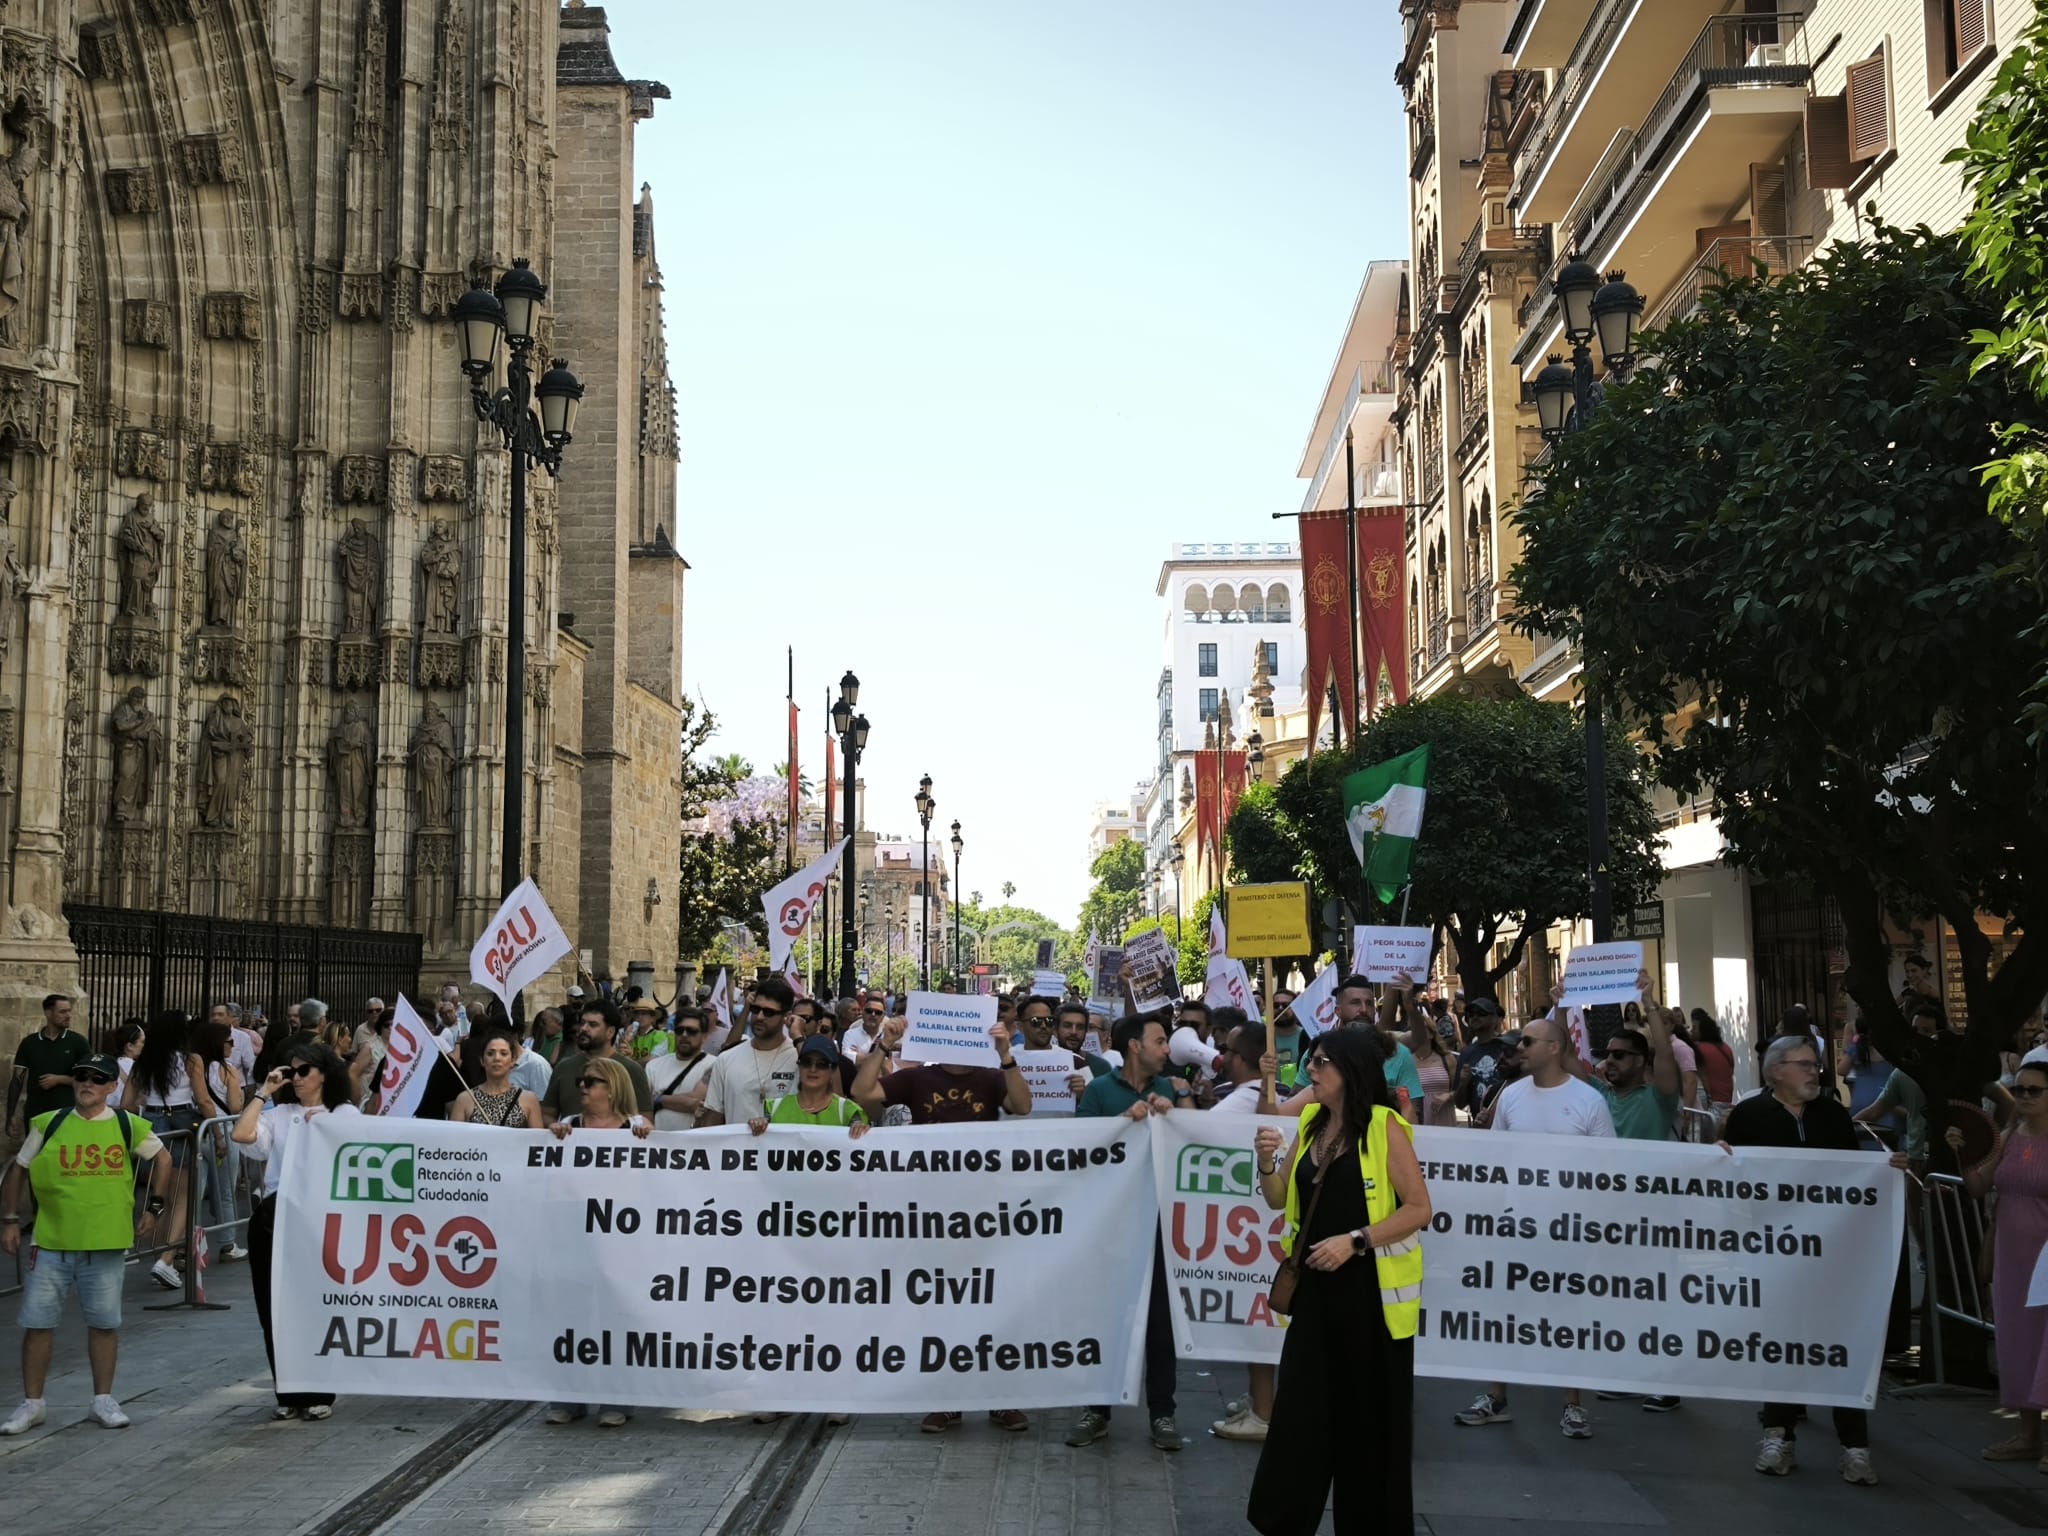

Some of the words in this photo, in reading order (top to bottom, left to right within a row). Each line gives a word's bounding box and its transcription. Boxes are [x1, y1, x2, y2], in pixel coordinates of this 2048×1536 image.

[1396, 940, 1426, 948] SUELDO
[1587, 954, 1614, 962] SALARIO
[1589, 969, 1616, 977] SALARIO
[1589, 983, 1616, 991] SALARIO
[919, 1007, 981, 1019] EQUIPARACIÓN
[916, 1022, 954, 1032] SALARIAL
[955, 1025, 983, 1034] ENTRE
[909, 1035, 990, 1049] ADMINISTRACIONES
[1036, 1065, 1069, 1073] SUELDO
[59, 1144, 124, 1170] USO
[418, 1147, 488, 1161] Federación
[527, 1146, 564, 1167] EN
[574, 1146, 711, 1171] DEFENSA
[721, 1149, 758, 1171] DE
[767, 1149, 842, 1172] UNOS
[850, 1149, 1001, 1172] SALARIOS
[1012, 1141, 1126, 1172] DIGNOS
[418, 1168, 473, 1182] Atención
[476, 1172, 485, 1182] a
[489, 1169, 501, 1183] la
[1419, 1161, 1509, 1185] EFENSA
[1518, 1167, 1550, 1187] DE
[1558, 1170, 1627, 1192] UNOS
[1634, 1175, 1769, 1201] SALARIOS
[1778, 1183, 1878, 1206] DIGNOS
[418, 1187, 489, 1202] Ciudadanía
[585, 1198, 641, 1234] No
[656, 1198, 743, 1236] más
[757, 1199, 1063, 1239] discriminación
[1421, 1210, 1453, 1234] o
[1465, 1207, 1538, 1239] más
[1550, 1212, 1822, 1257] discriminación
[322, 1212, 498, 1289] USO
[1174, 1266, 1214, 1281] UNIÓN
[1217, 1270, 1273, 1285] SINDICAL
[1461, 1260, 1494, 1289] al
[1507, 1262, 1667, 1302] Personal
[1680, 1273, 1761, 1308] Civil
[650, 1266, 689, 1301] al
[704, 1266, 891, 1304] Personal
[906, 1267, 995, 1305] Civil
[323, 1291, 374, 1307] UNIÓN
[379, 1294, 443, 1308] SINDICAL
[447, 1296, 498, 1311] OBRERA
[317, 1315, 502, 1361] APLAGE
[1440, 1310, 1626, 1352] Ministerio
[1638, 1326, 1683, 1357] de
[1697, 1329, 1848, 1367] Defensa
[553, 1328, 612, 1365] del
[626, 1331, 842, 1372] Ministerio
[856, 1336, 906, 1372] de
[920, 1334, 1101, 1373] Defensa
